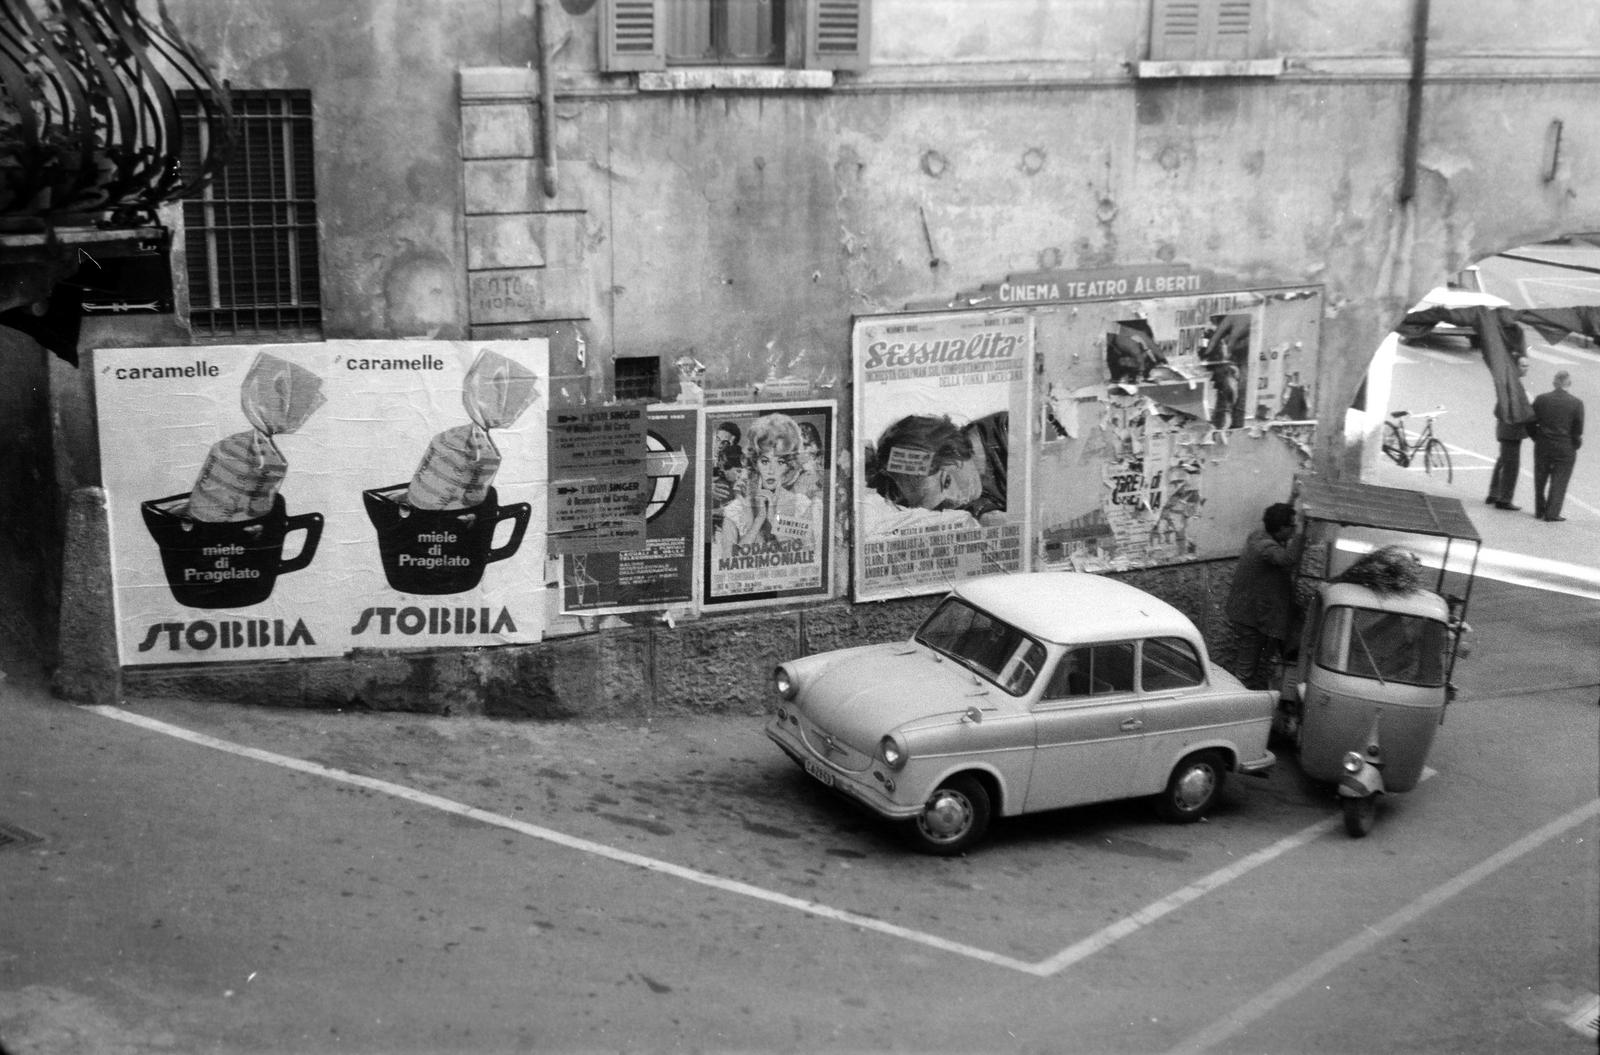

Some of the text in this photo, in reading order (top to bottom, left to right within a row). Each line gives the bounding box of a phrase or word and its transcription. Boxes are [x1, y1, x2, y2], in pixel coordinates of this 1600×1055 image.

[1000, 275, 1201, 302] CINEMA TEATRO ALBERTI
[115, 360, 220, 381] caramelle
[346, 354, 444, 372] caramelle
[417, 531, 457, 543] miele
[202, 543, 245, 556] miele
[428, 544, 442, 557] di
[732, 537, 803, 557] RODAGGIO
[214, 557, 229, 569] di
[398, 553, 471, 570] Pragelato
[718, 550, 815, 571] MATRIMONIALE
[184, 567, 260, 583] Pragelato
[350, 605, 518, 637] STOBBIA
[138, 617, 316, 653] STOBBIA
